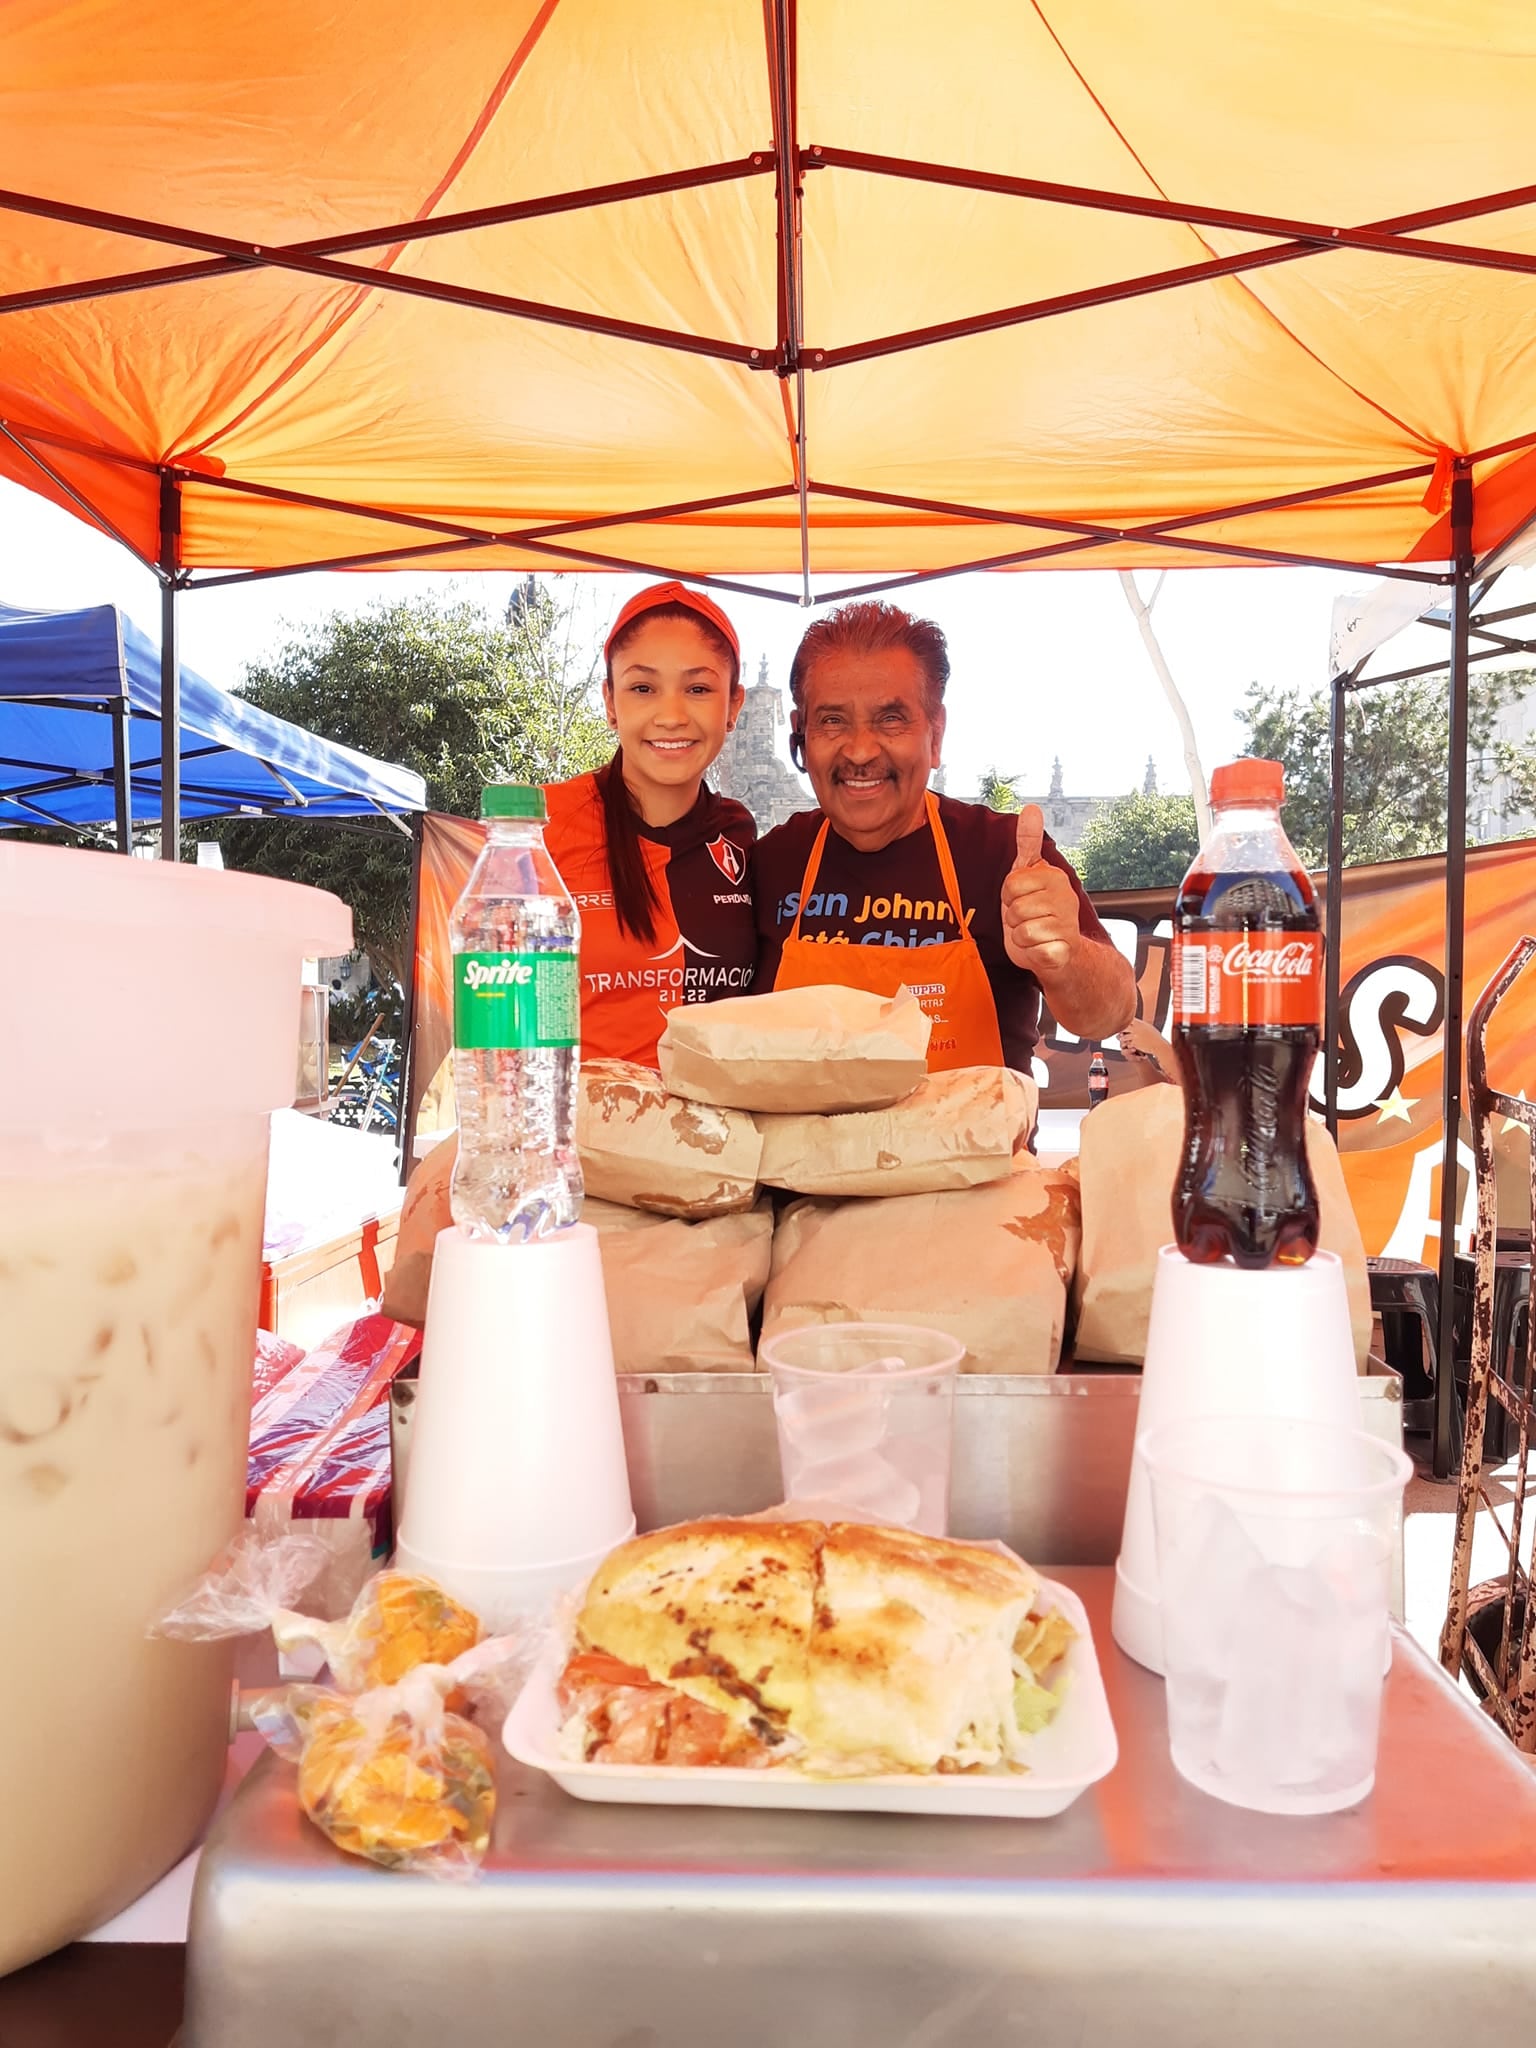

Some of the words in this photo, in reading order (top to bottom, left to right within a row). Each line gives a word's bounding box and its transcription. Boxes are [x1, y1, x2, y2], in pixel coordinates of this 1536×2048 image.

[573, 893, 616, 907] RRE
[860, 928, 962, 949] Chid
[1222, 942, 1314, 976] Coca-Cola
[463, 959, 533, 990] Sprite
[584, 963, 754, 993] TRANSFORMACIÓ
[659, 989, 706, 1002] 21-22
[920, 998, 944, 1008] RTAS
